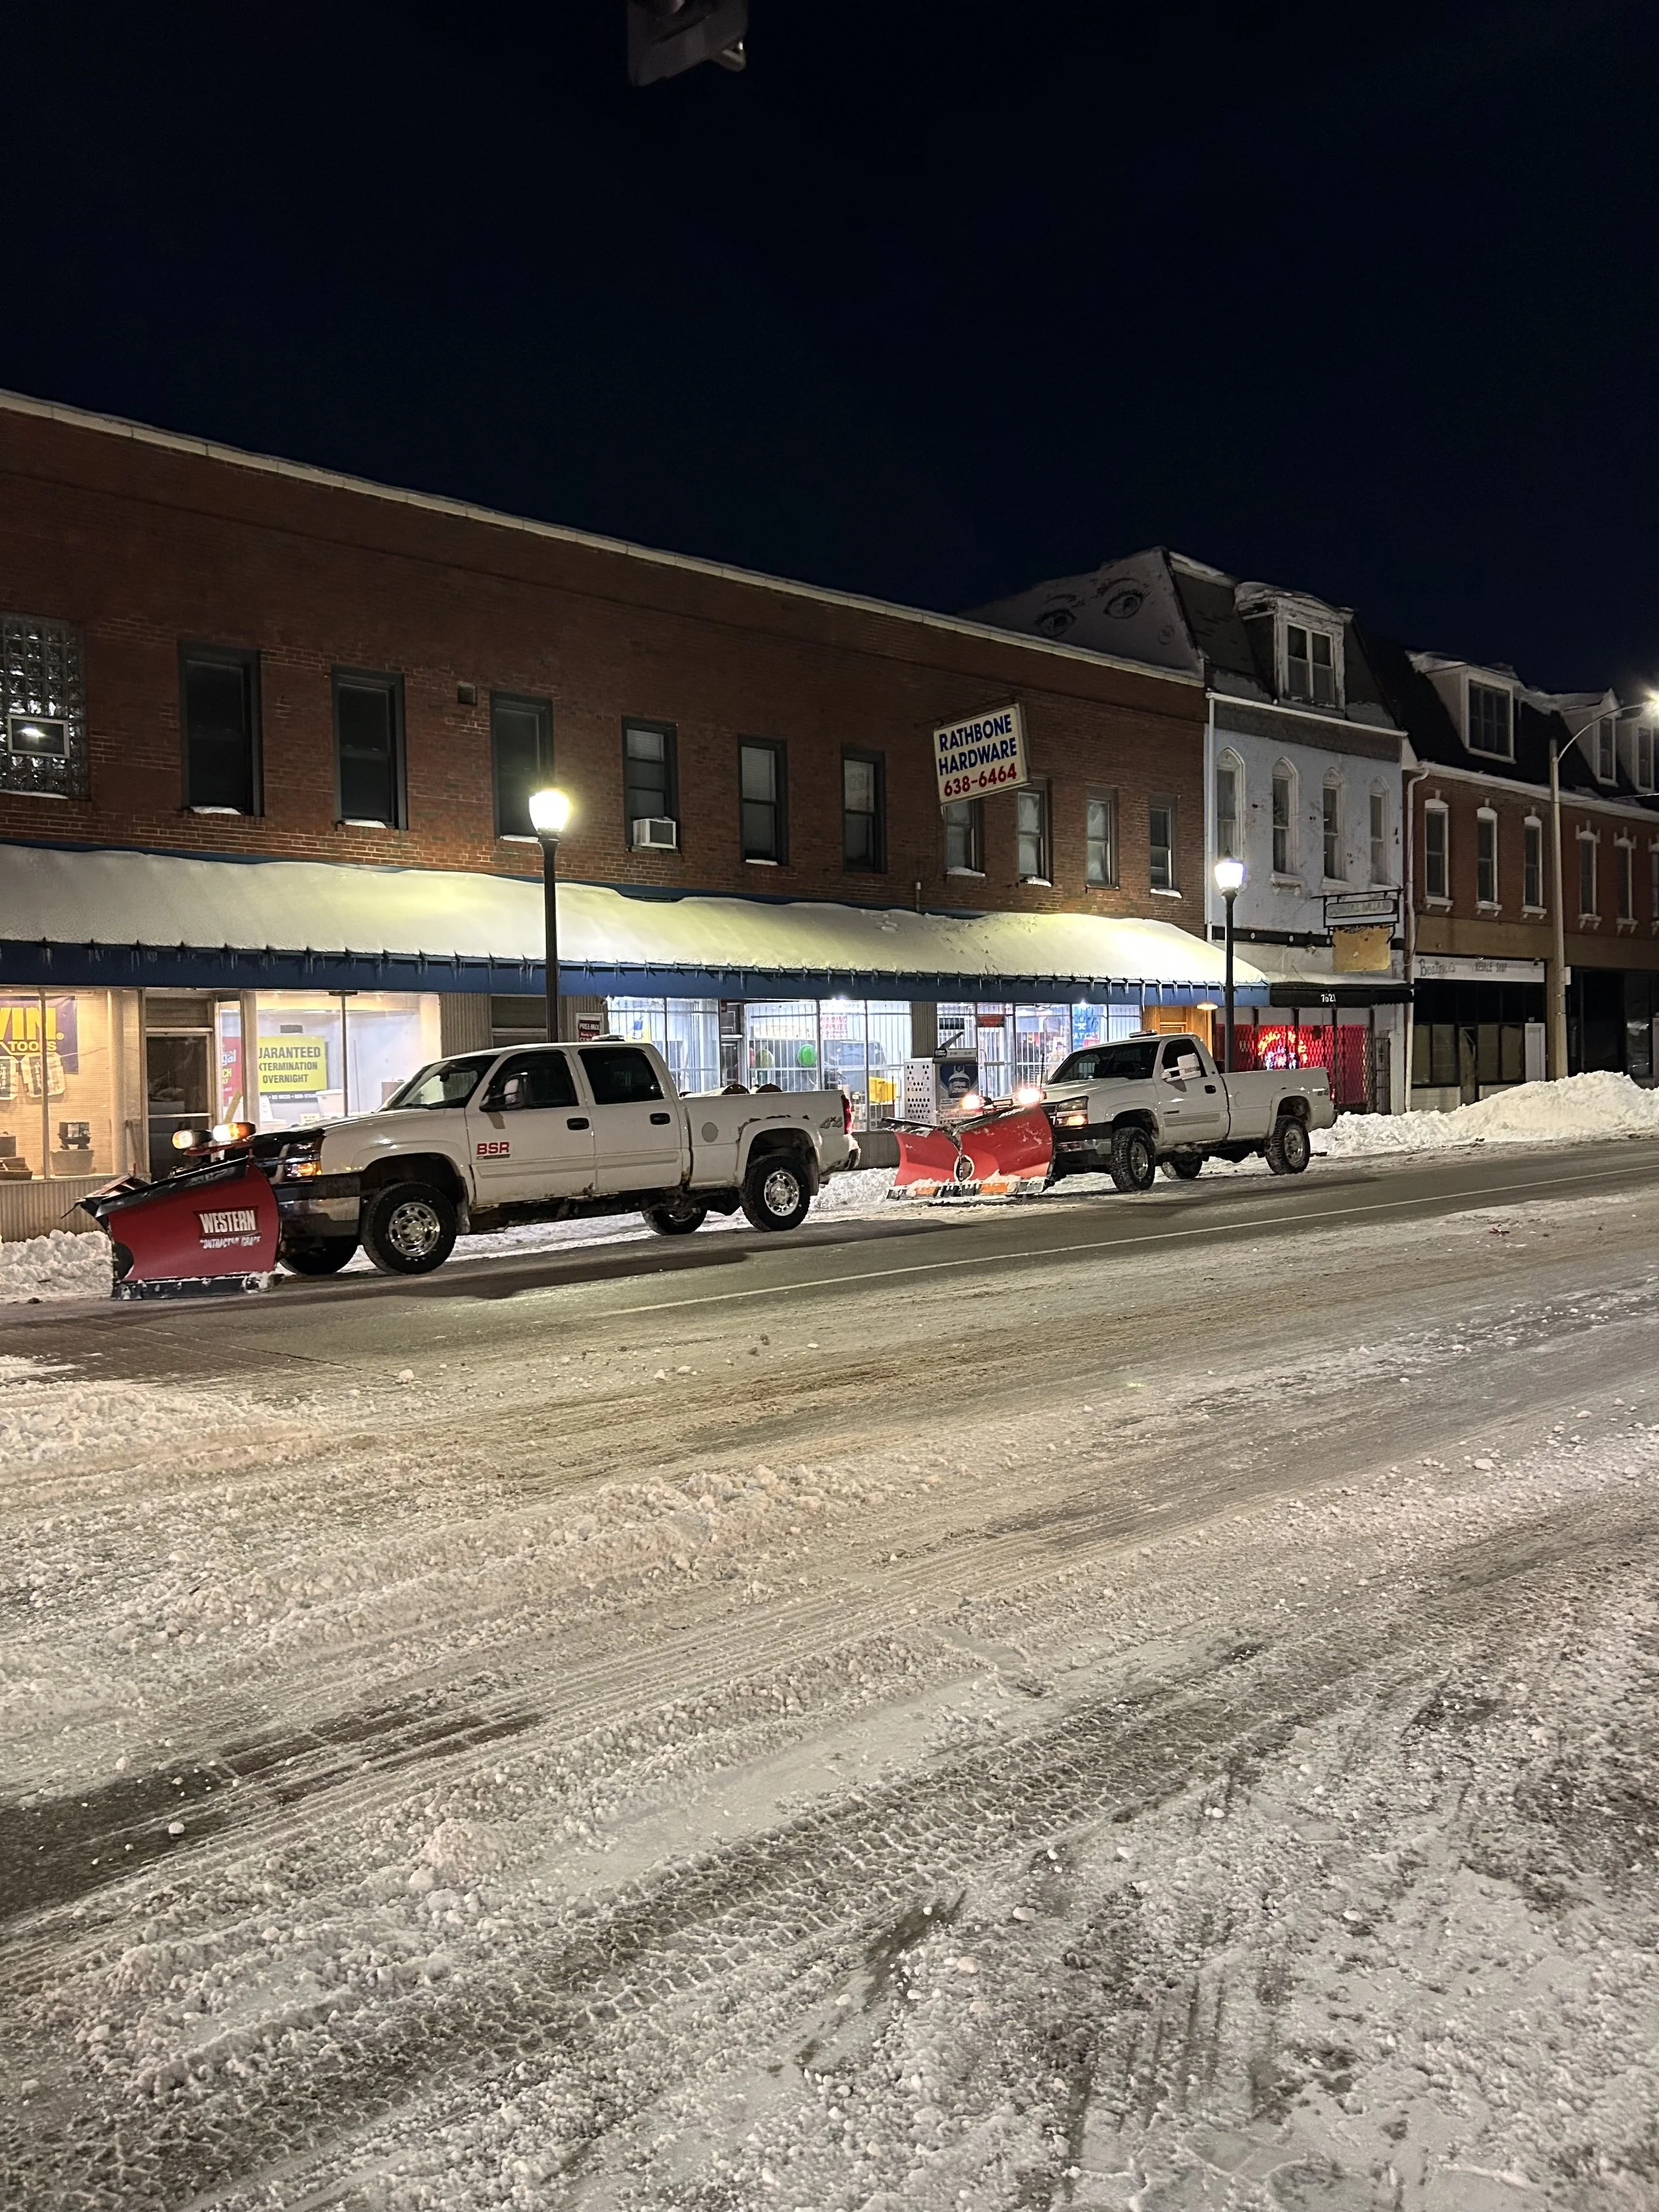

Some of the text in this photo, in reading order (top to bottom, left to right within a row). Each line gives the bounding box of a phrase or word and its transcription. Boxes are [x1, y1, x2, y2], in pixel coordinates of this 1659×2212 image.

[939, 713, 1012, 753] RATHBONE
[938, 737, 1017, 776] HARDWARE
[944, 763, 1017, 797] 638-6464
[7, 1041, 57, 1052] TOOS
[262, 1074, 309, 1084] OVERNIGHT
[476, 1142, 510, 1155] BSR
[199, 1210, 256, 1234] WESTERN
